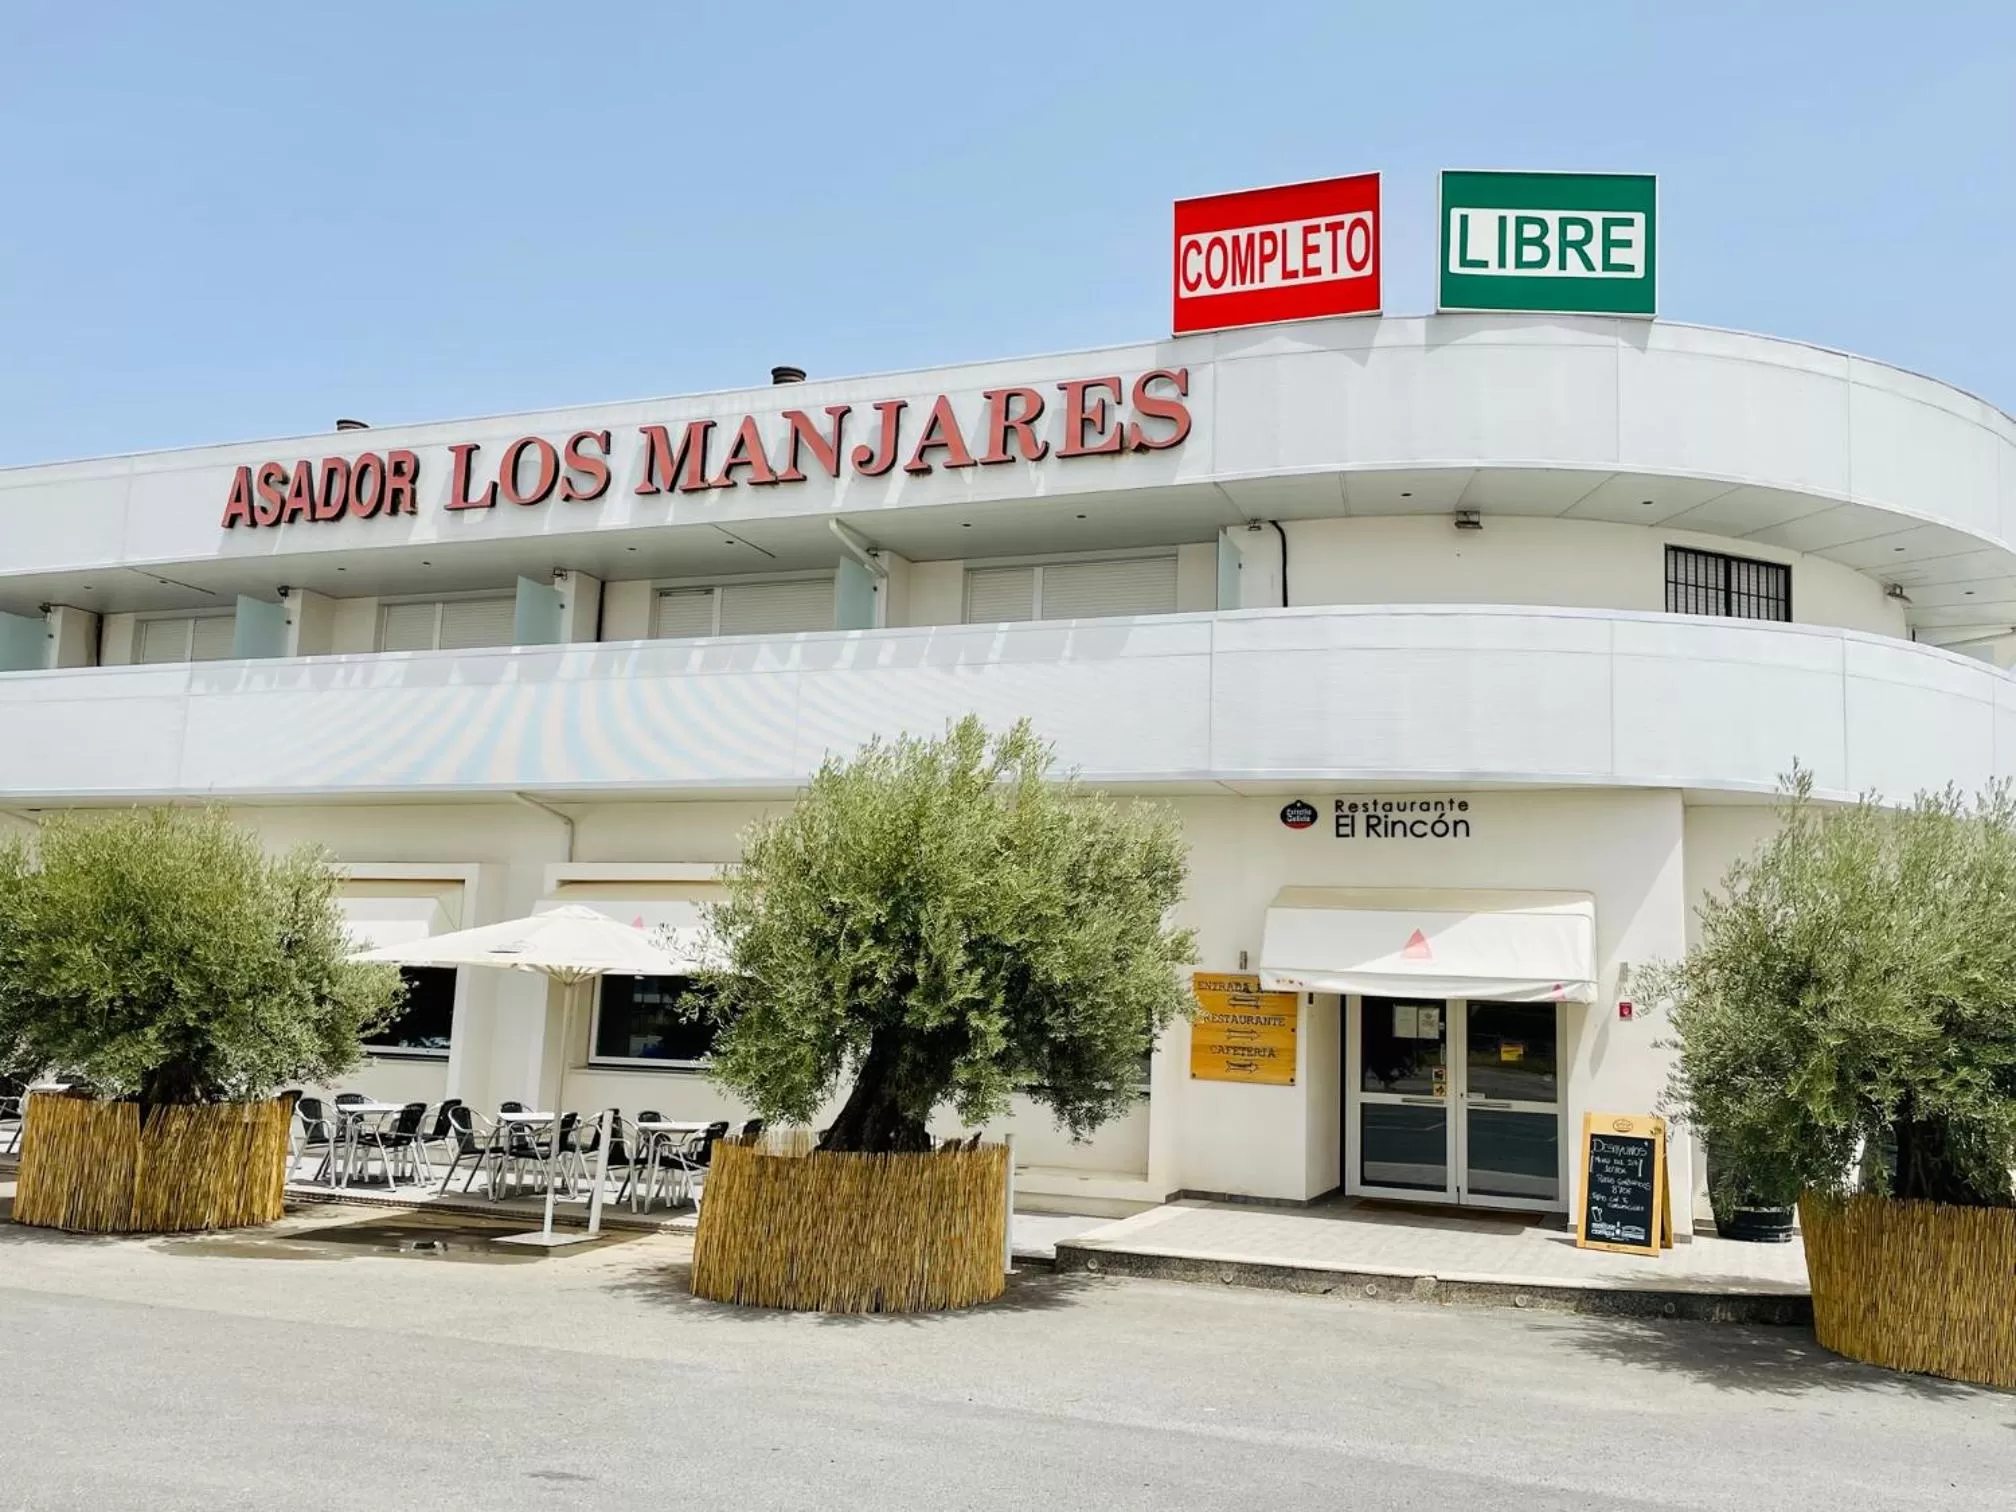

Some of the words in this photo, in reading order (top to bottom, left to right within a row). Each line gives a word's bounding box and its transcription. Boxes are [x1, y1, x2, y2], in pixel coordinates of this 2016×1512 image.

[1181, 217, 1374, 292] COMPLETO
[1458, 214, 1636, 273] LIBRE
[221, 450, 419, 528] ASADOR
[444, 430, 612, 511] LOS
[634, 368, 1192, 495] MANJARES
[1335, 798, 1469, 812] Restaurante
[1335, 815, 1356, 838] El
[1366, 813, 1470, 837] Rincón
[1198, 981, 1251, 993] ENTRADA
